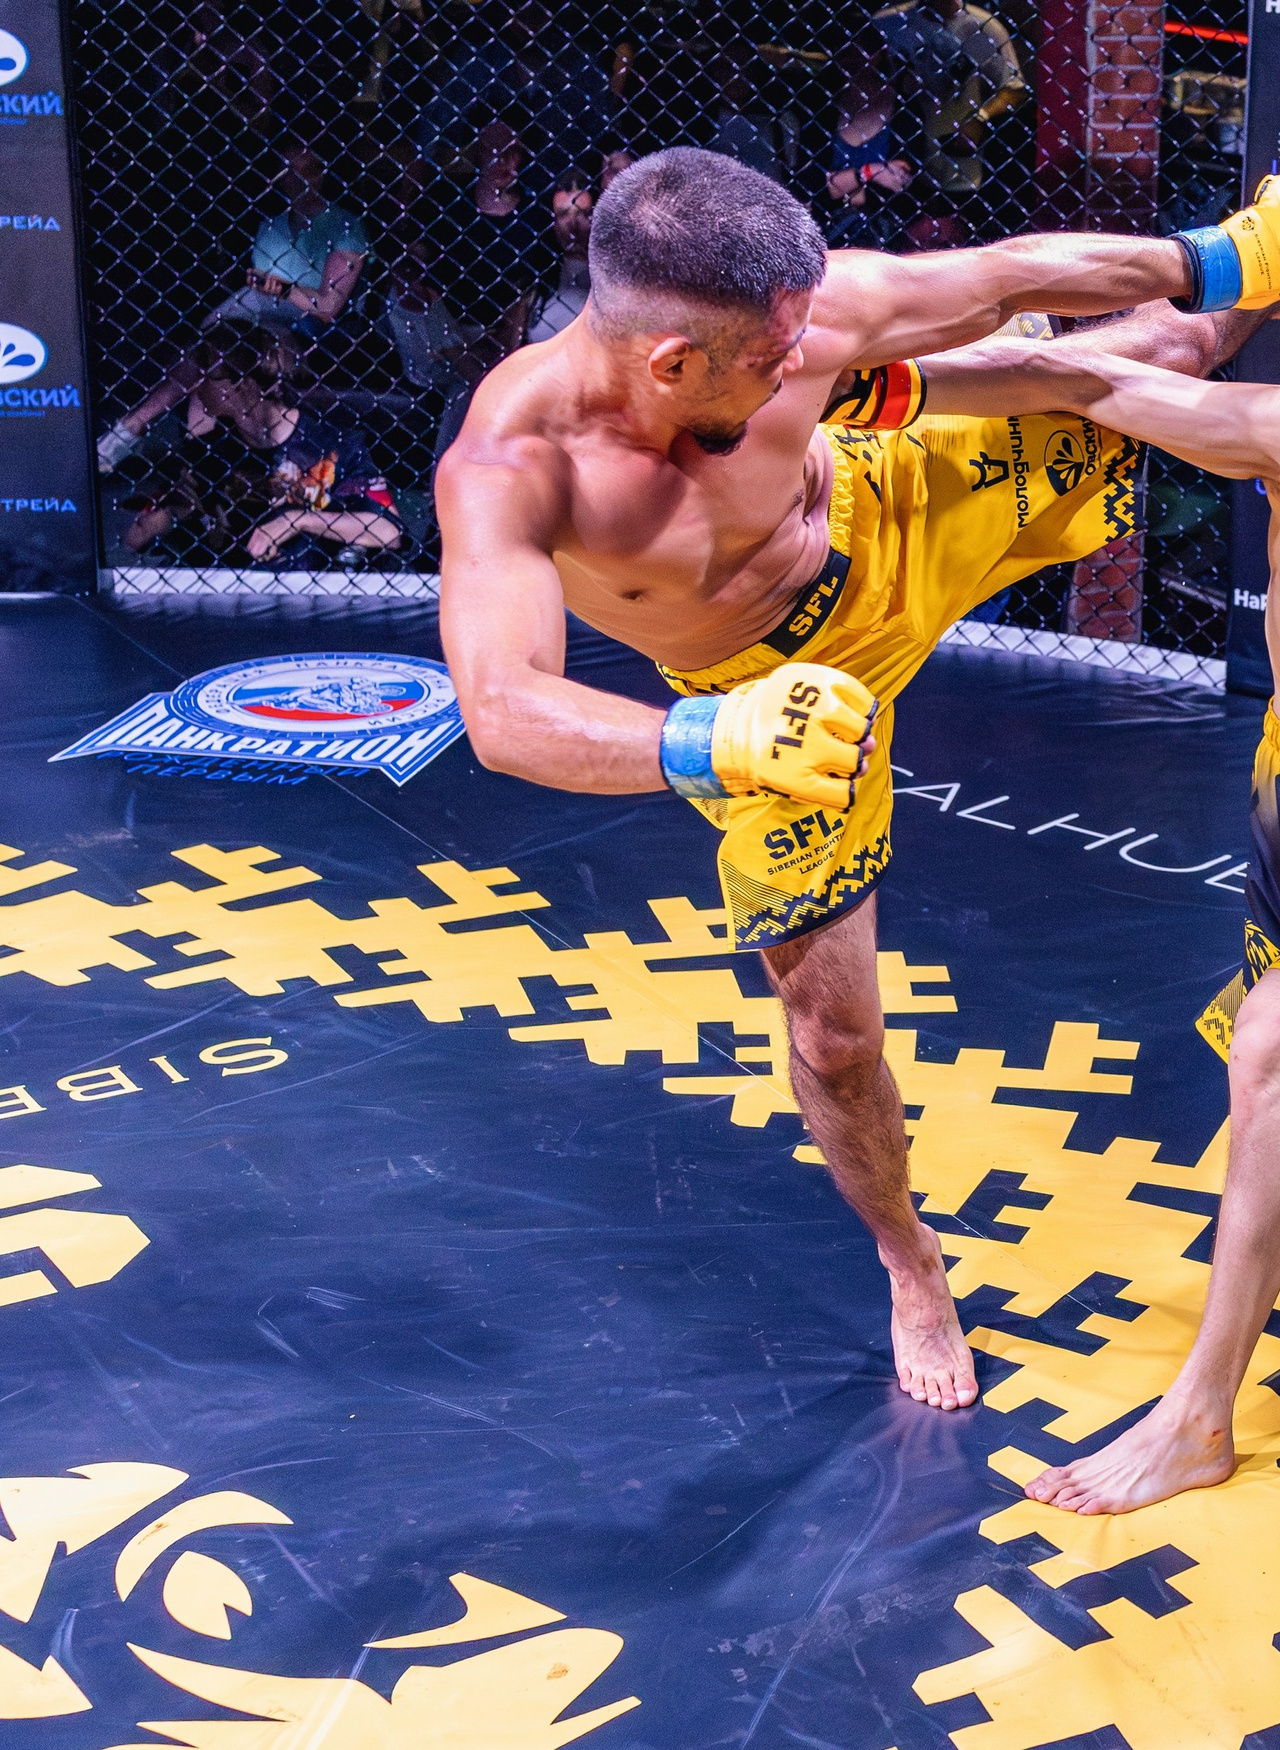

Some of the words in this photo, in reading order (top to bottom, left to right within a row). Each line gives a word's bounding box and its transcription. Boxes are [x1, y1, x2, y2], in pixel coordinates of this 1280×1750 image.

[0, 90, 64, 116] кий
[0, 383, 81, 408] ский
[788, 576, 839, 637] SFL
[94, 700, 455, 768] ПАНКРАТИОН
[771, 682, 821, 760] SFL
[764, 809, 844, 860] SFL
[767, 852, 813, 876] SIBERIAN
[799, 850, 835, 875] LEAGUE
